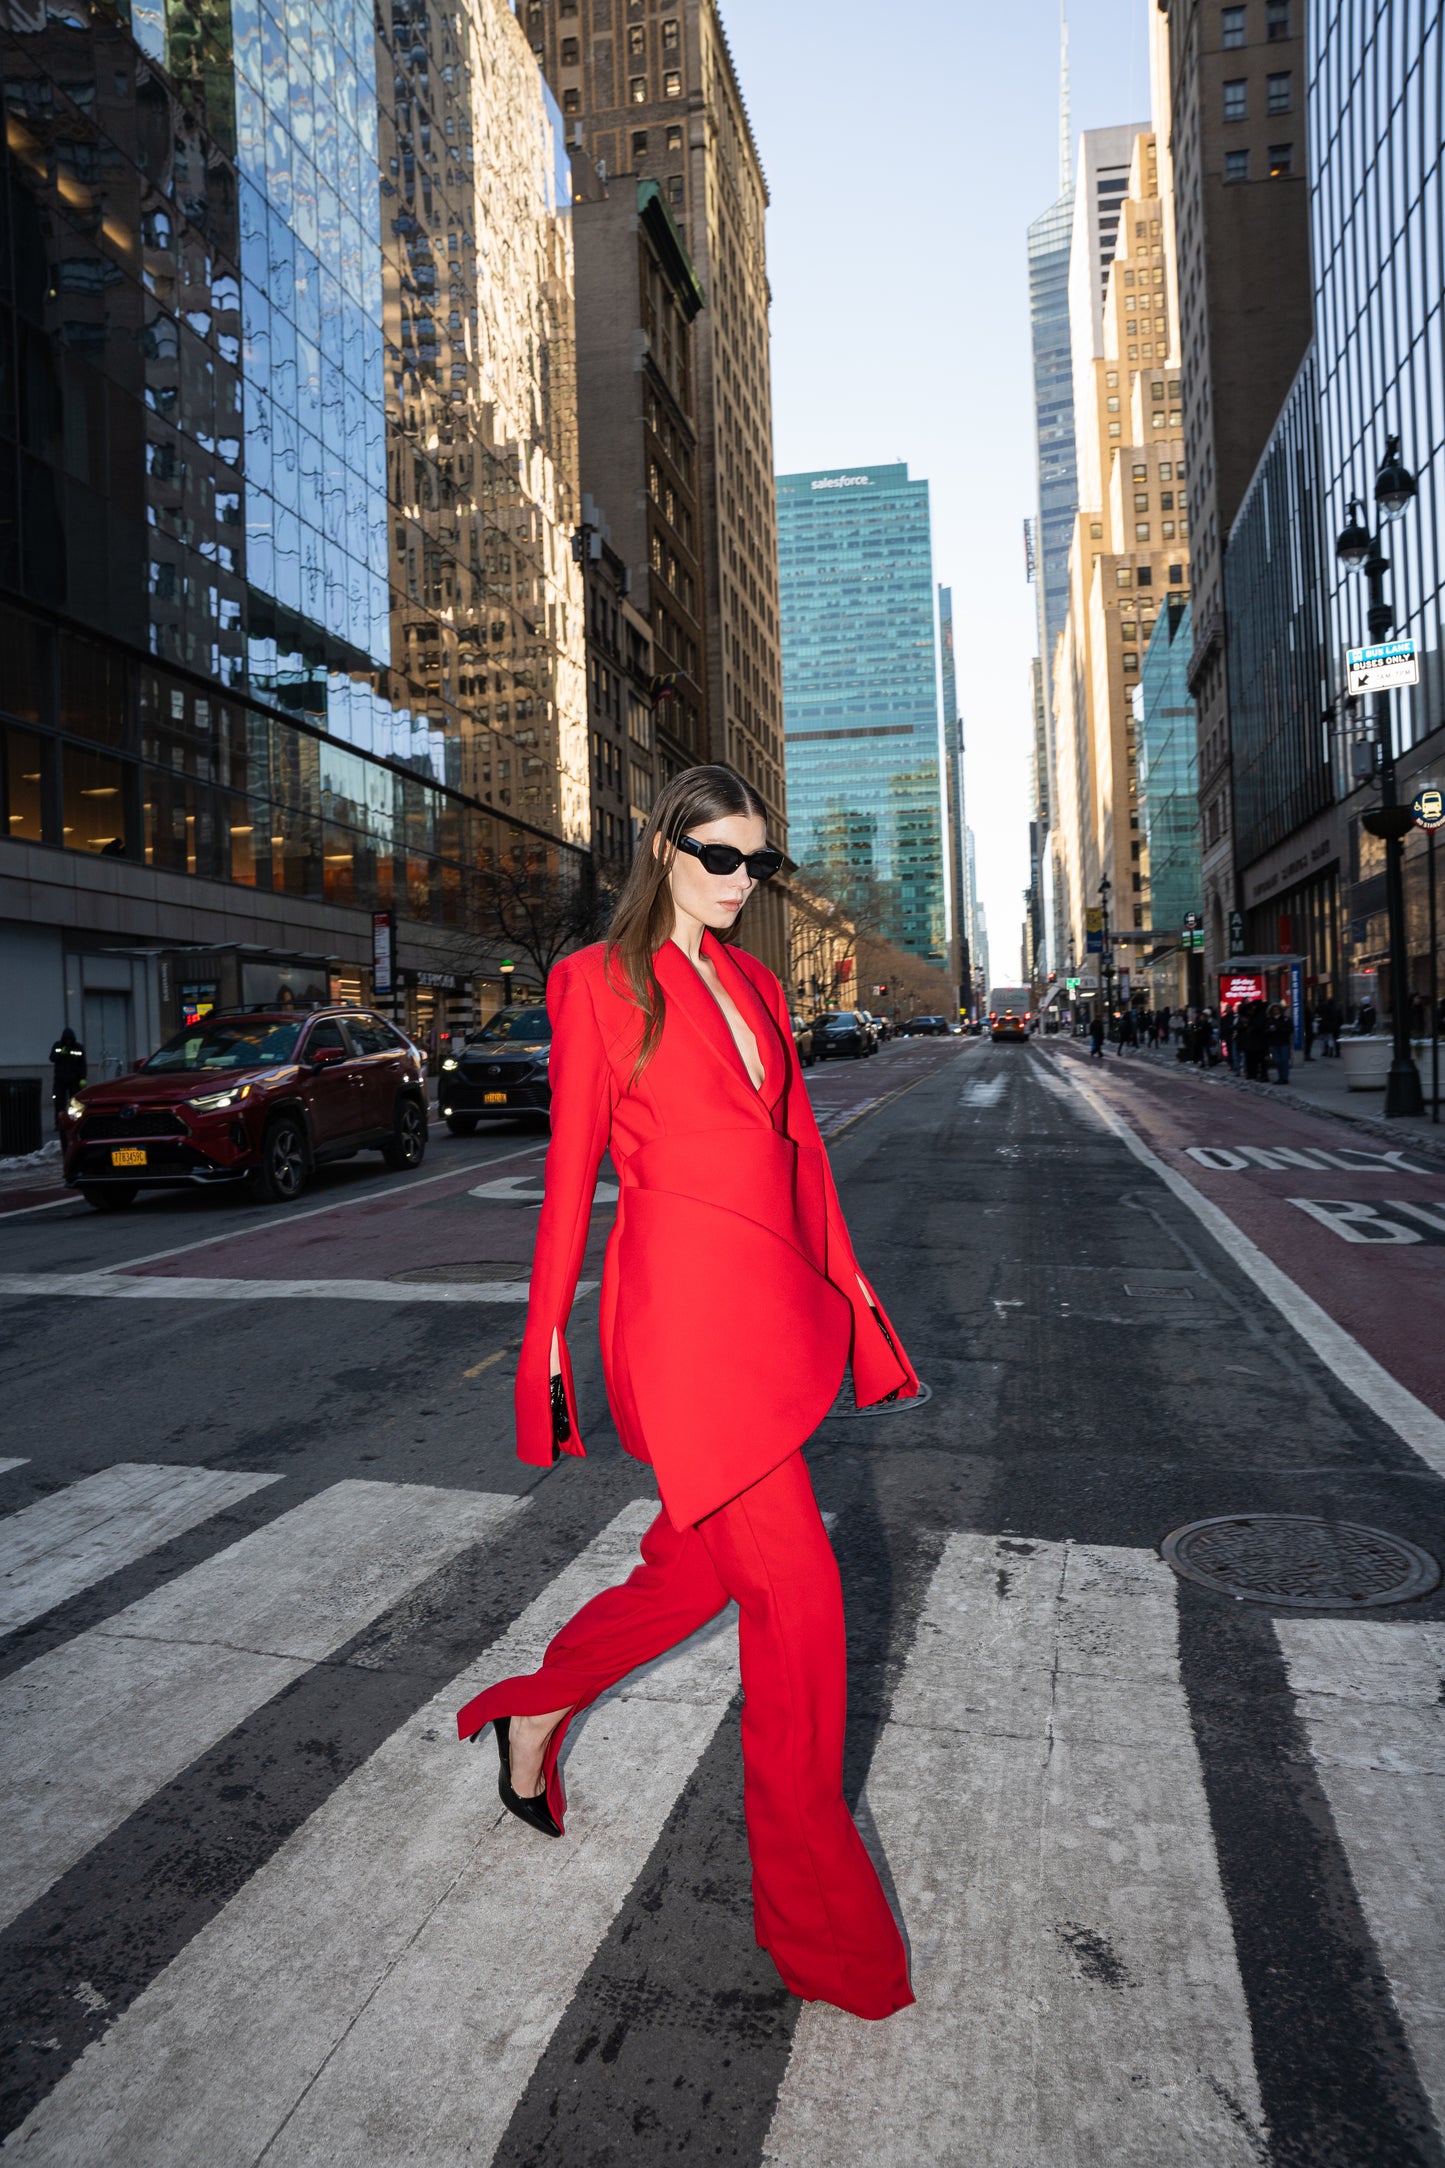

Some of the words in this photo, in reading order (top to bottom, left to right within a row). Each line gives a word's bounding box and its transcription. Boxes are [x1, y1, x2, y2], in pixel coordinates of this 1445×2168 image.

[811, 475, 868, 490] salesforce
[1366, 648, 1384, 658] BUS
[1386, 643, 1411, 654] LANE
[1353, 659, 1384, 671] BUSES
[1386, 654, 1411, 664] ONLY
[1231, 913, 1243, 952] ATM
[1184, 1146, 1434, 1174] ONLY
